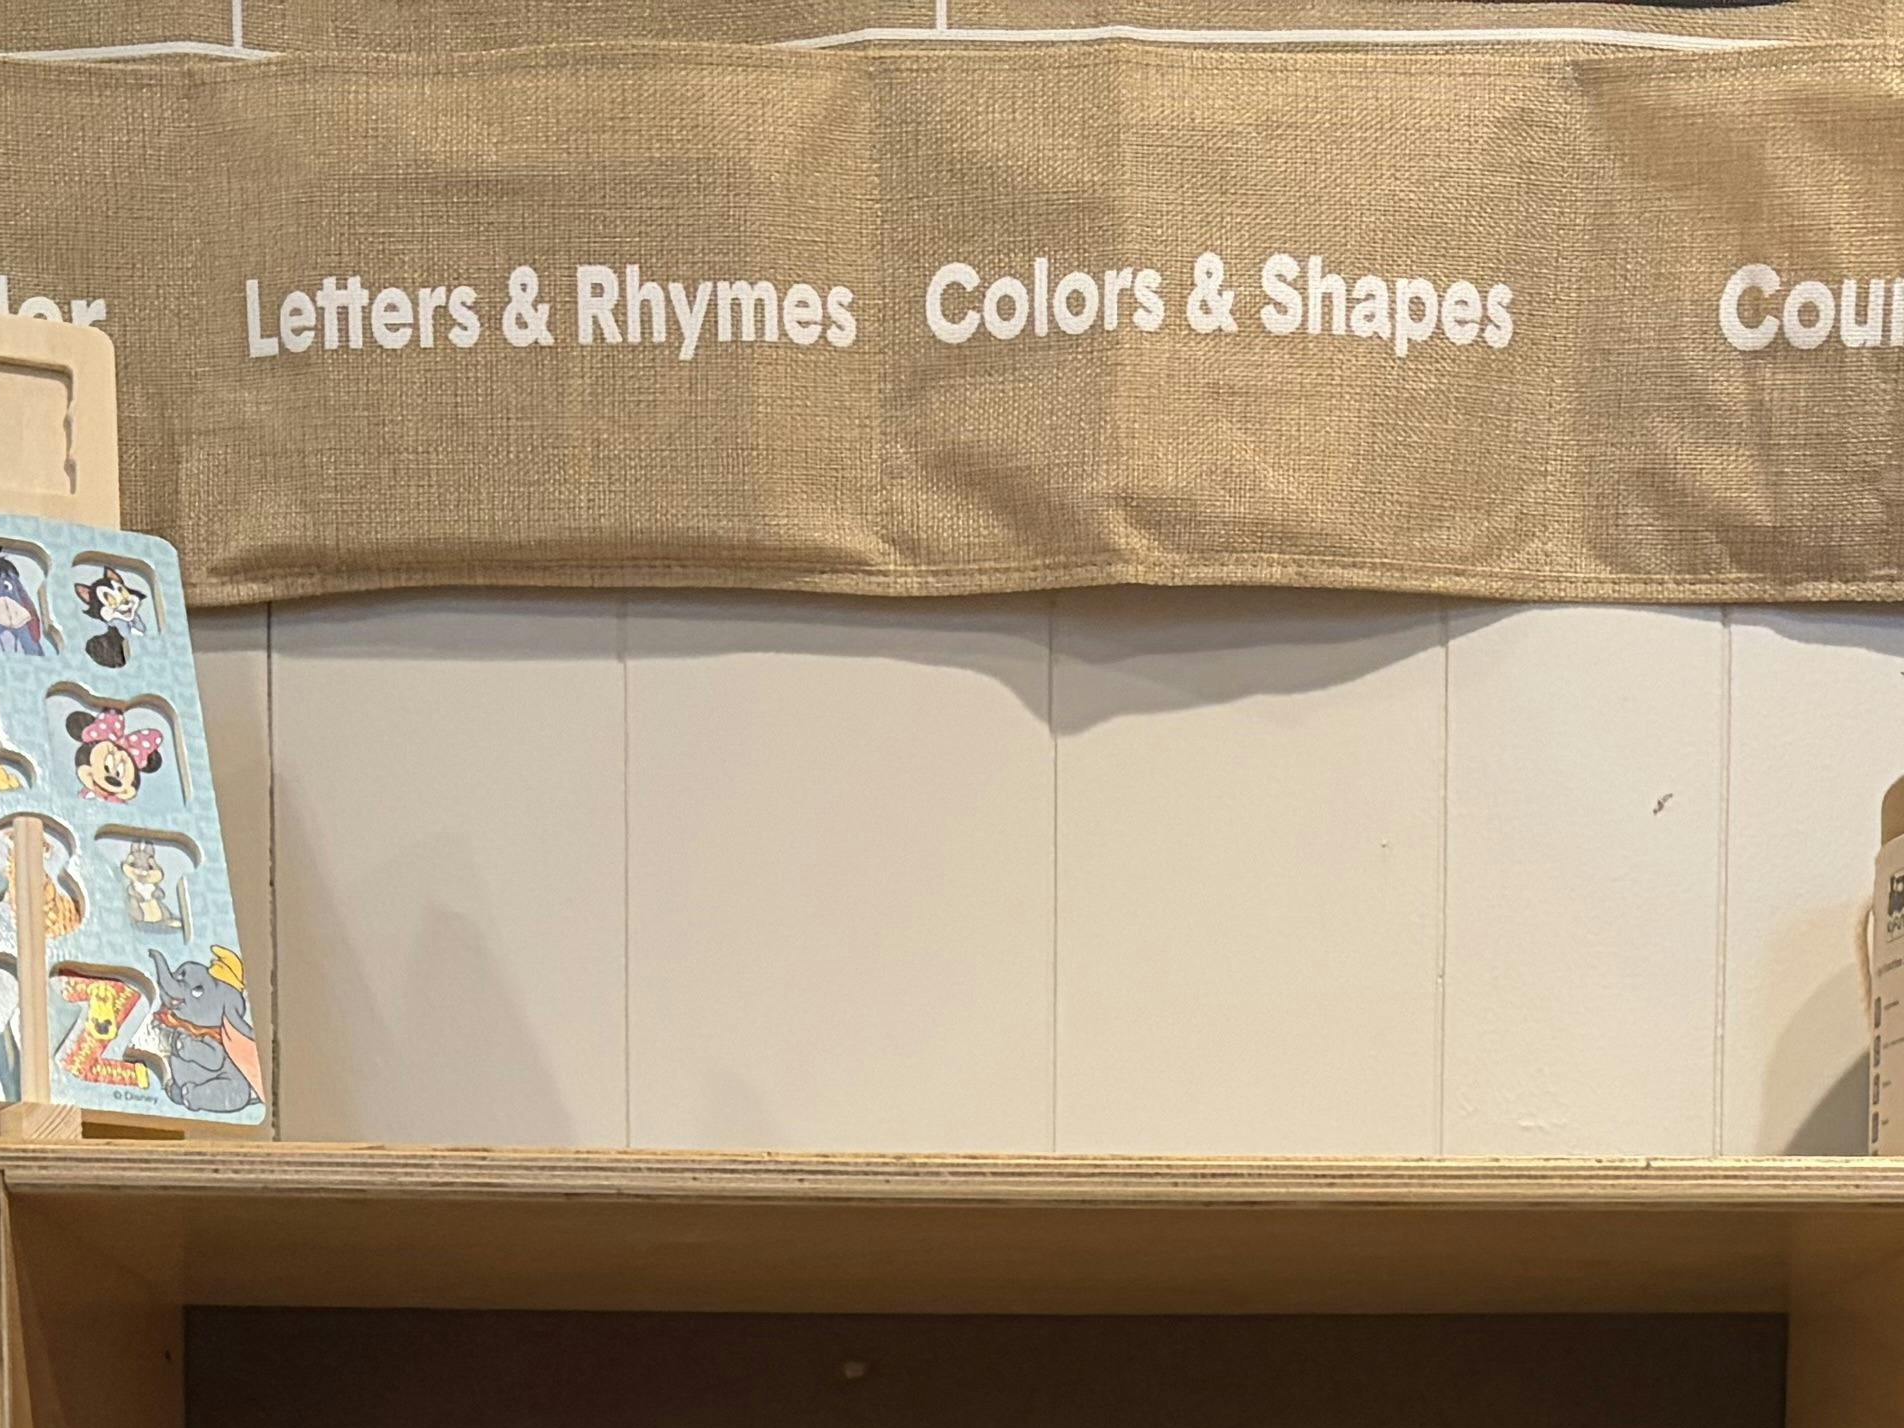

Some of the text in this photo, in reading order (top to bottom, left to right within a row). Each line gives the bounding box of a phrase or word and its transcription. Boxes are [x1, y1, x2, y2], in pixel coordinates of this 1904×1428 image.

[245, 264, 857, 362] Letters & Rhymes
[924, 251, 1514, 358] Colors & Shapes
